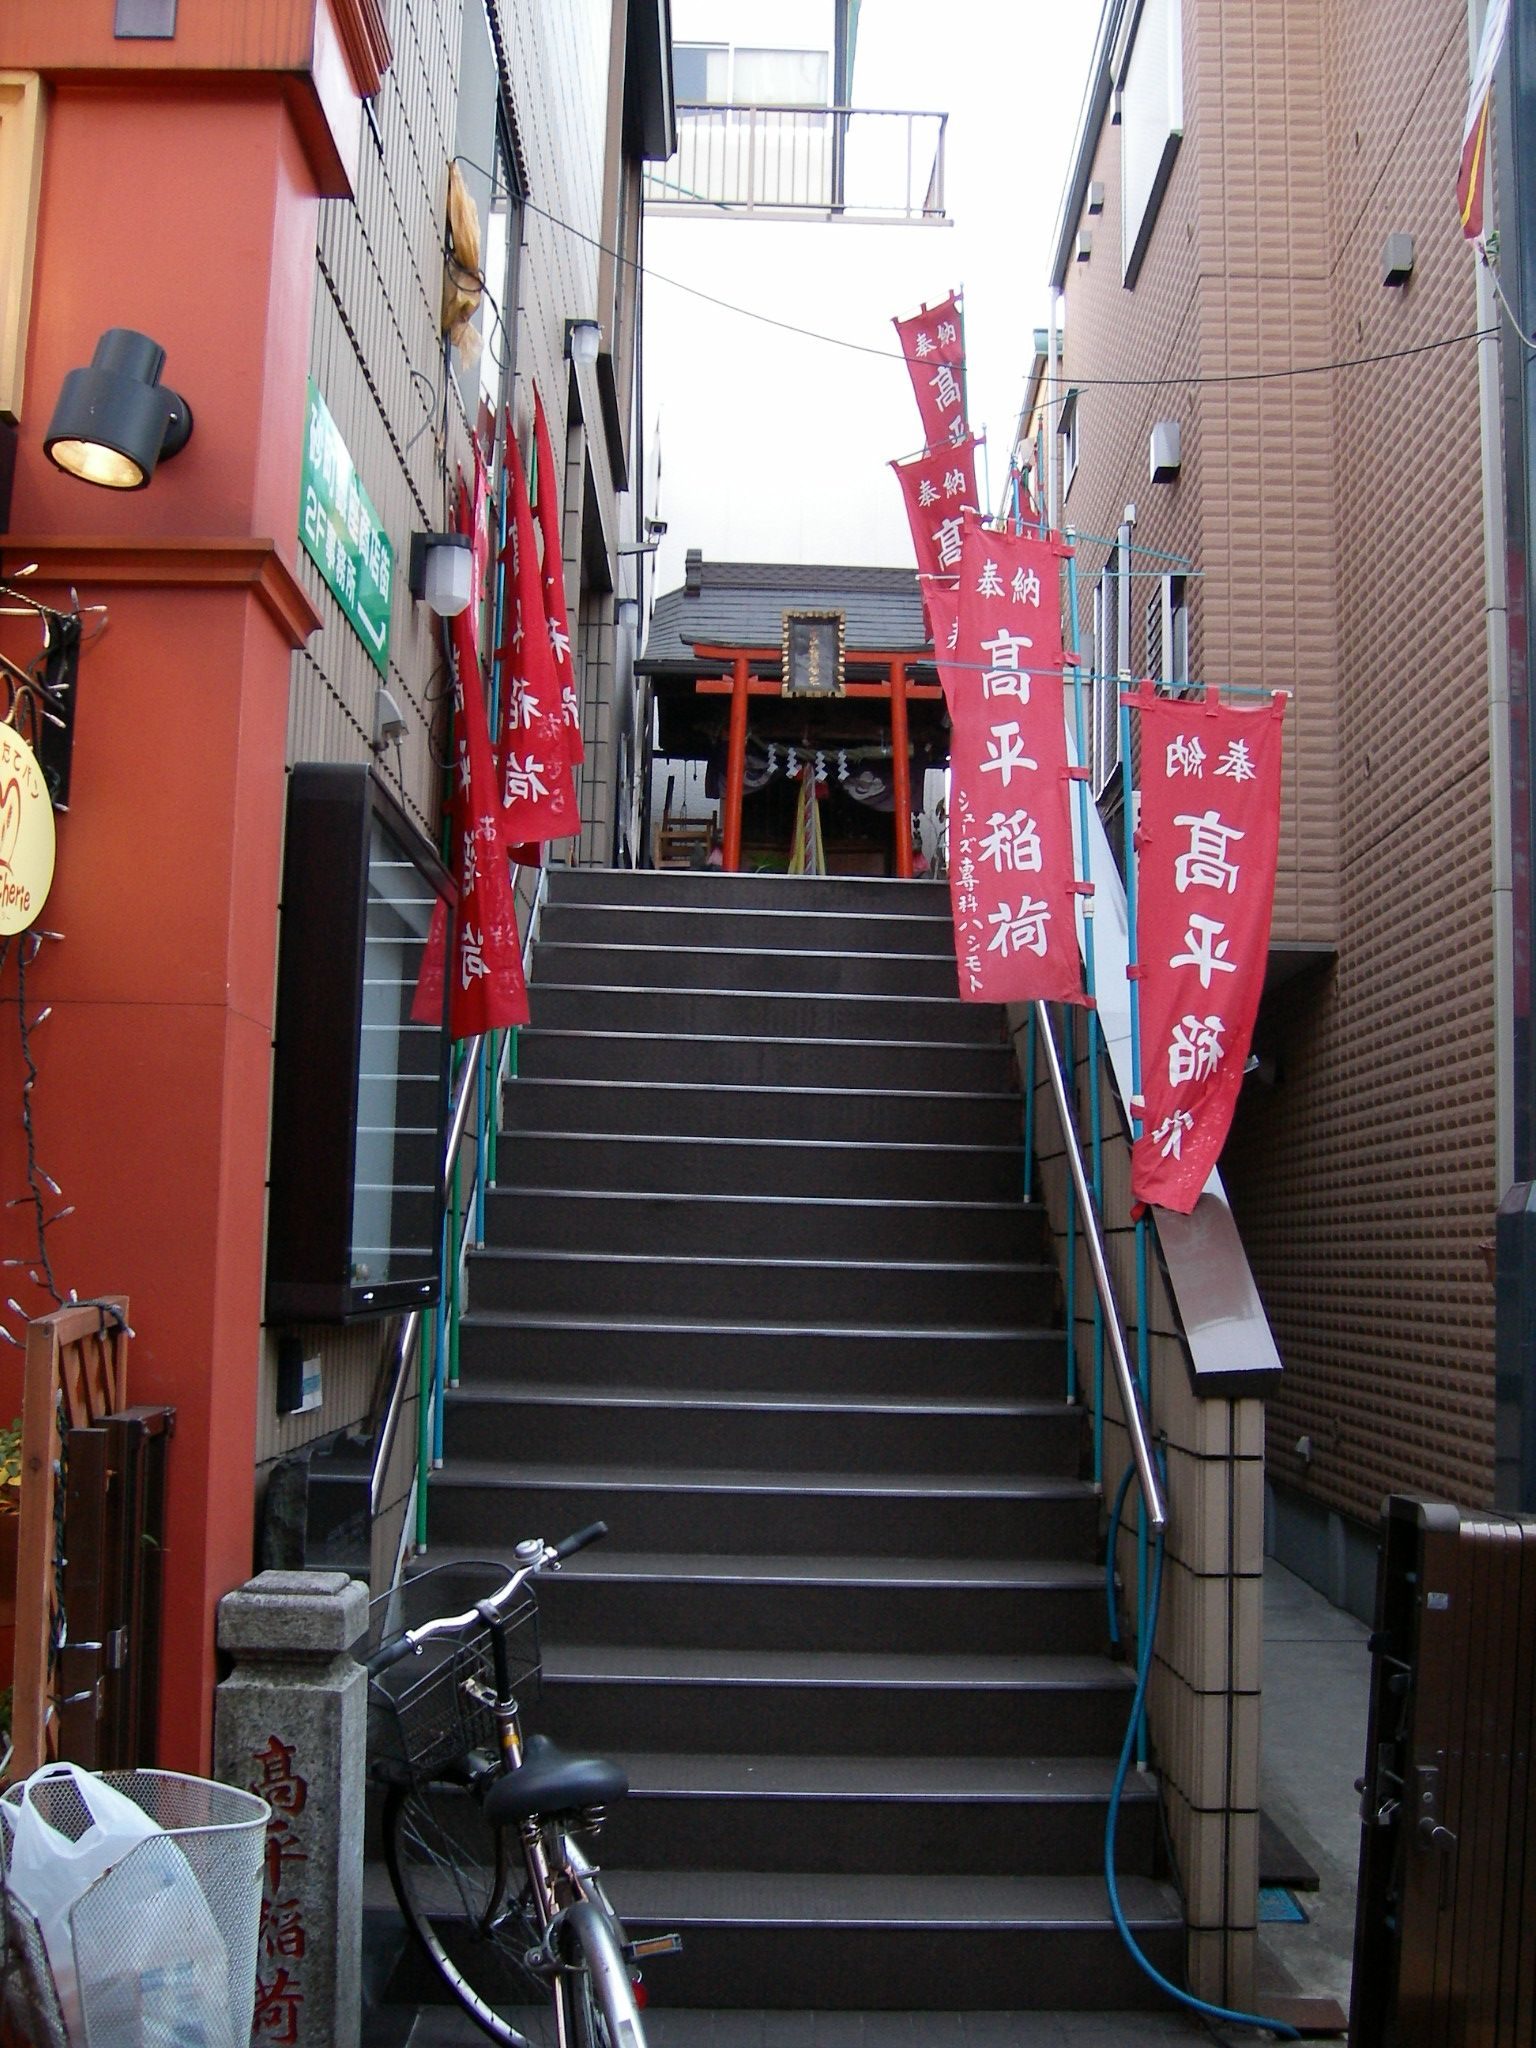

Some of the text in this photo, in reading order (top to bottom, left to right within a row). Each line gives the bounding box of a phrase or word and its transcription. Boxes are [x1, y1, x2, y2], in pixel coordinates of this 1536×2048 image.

[914, 321, 957, 358] 奉納
[918, 468, 967, 508] 奉納
[304, 485, 357, 610] 2F事務所
[975, 558, 1042, 609] 奉納
[0, 873, 32, 912] herie
